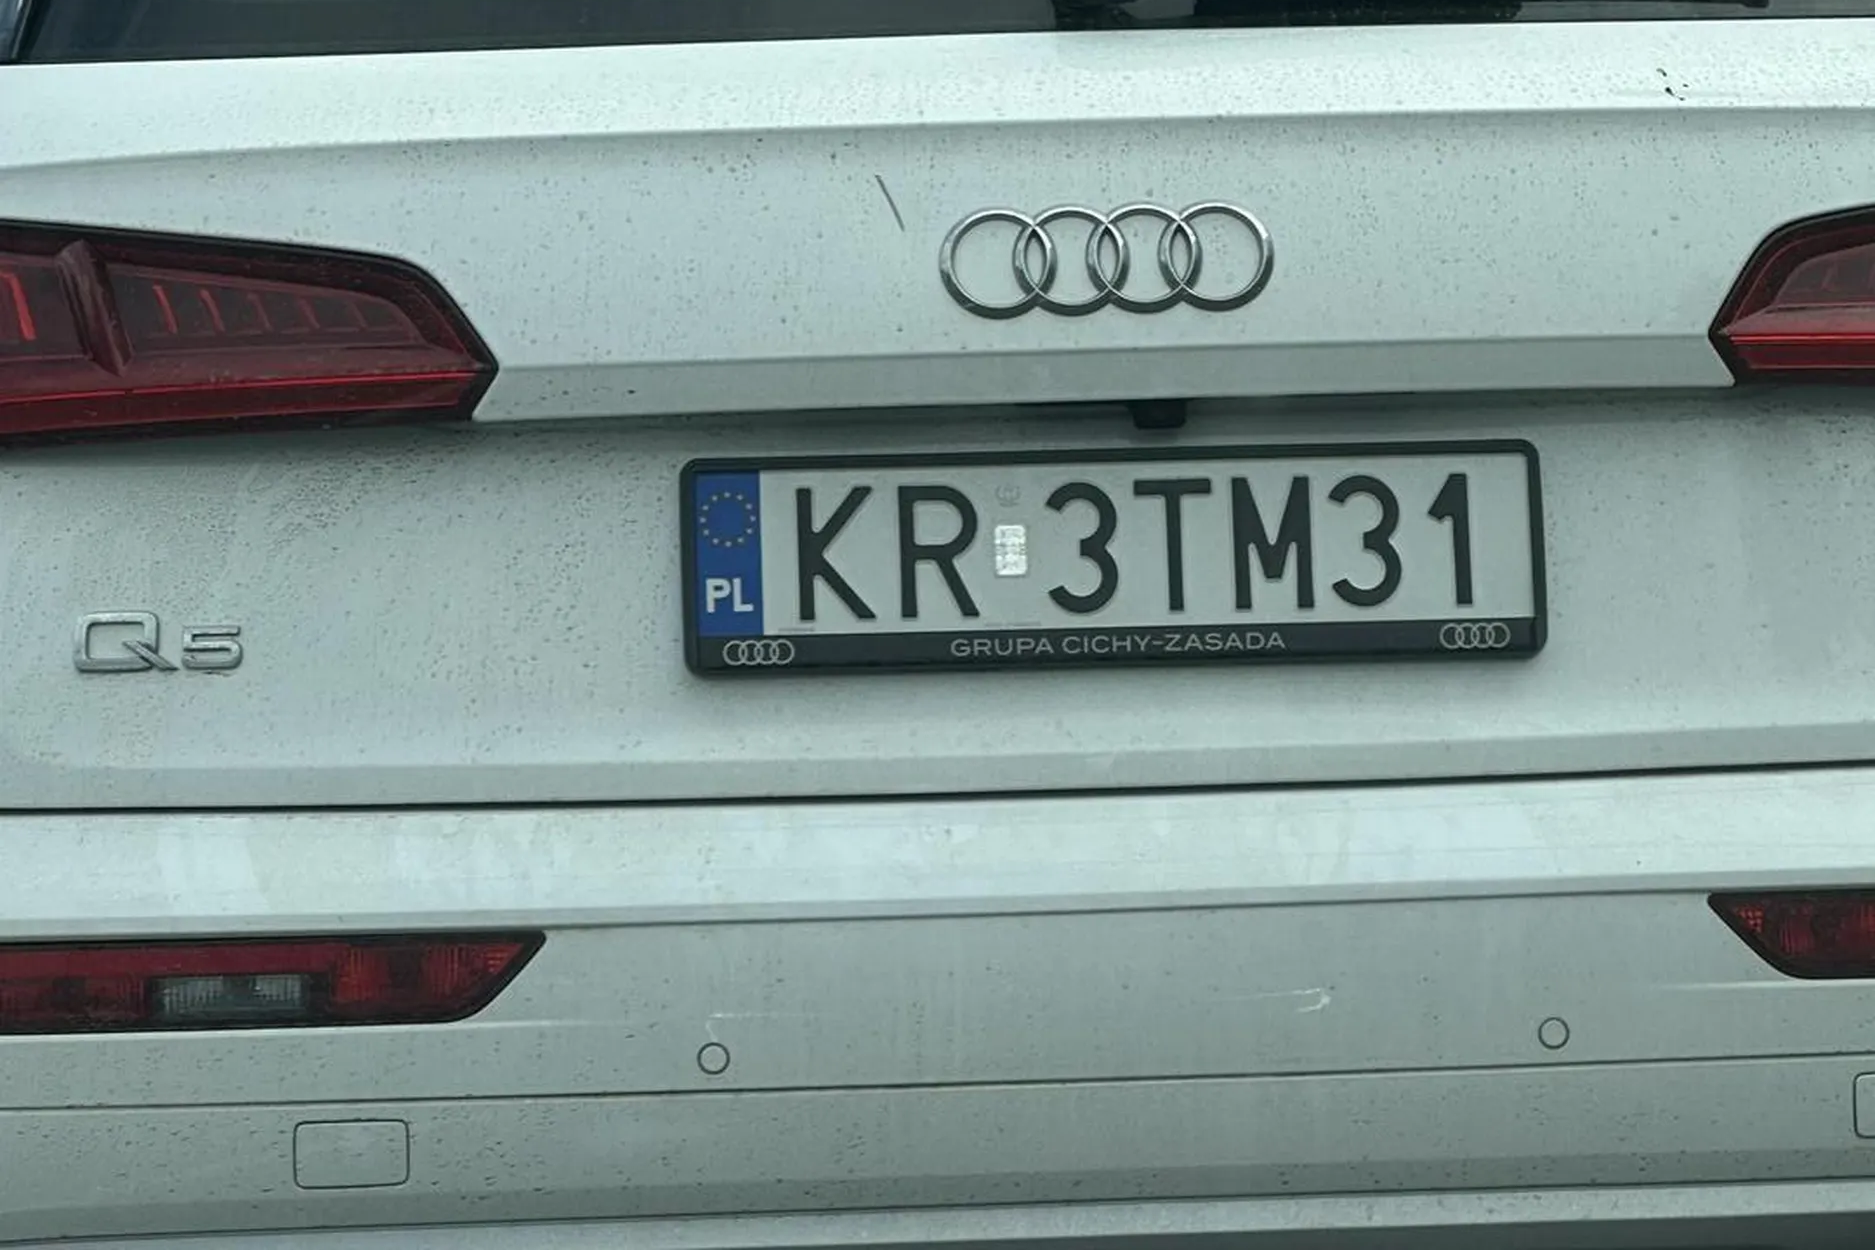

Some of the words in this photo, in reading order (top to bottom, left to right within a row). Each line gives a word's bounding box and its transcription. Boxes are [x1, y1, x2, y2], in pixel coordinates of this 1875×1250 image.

[795, 485, 980, 622] KR
[1045, 472, 1474, 615] 3TM31
[706, 577, 755, 613] PL
[74, 610, 244, 673] Q5
[950, 637, 1054, 658] GRUPA
[1061, 631, 1287, 655] CICHY-ZASADA
